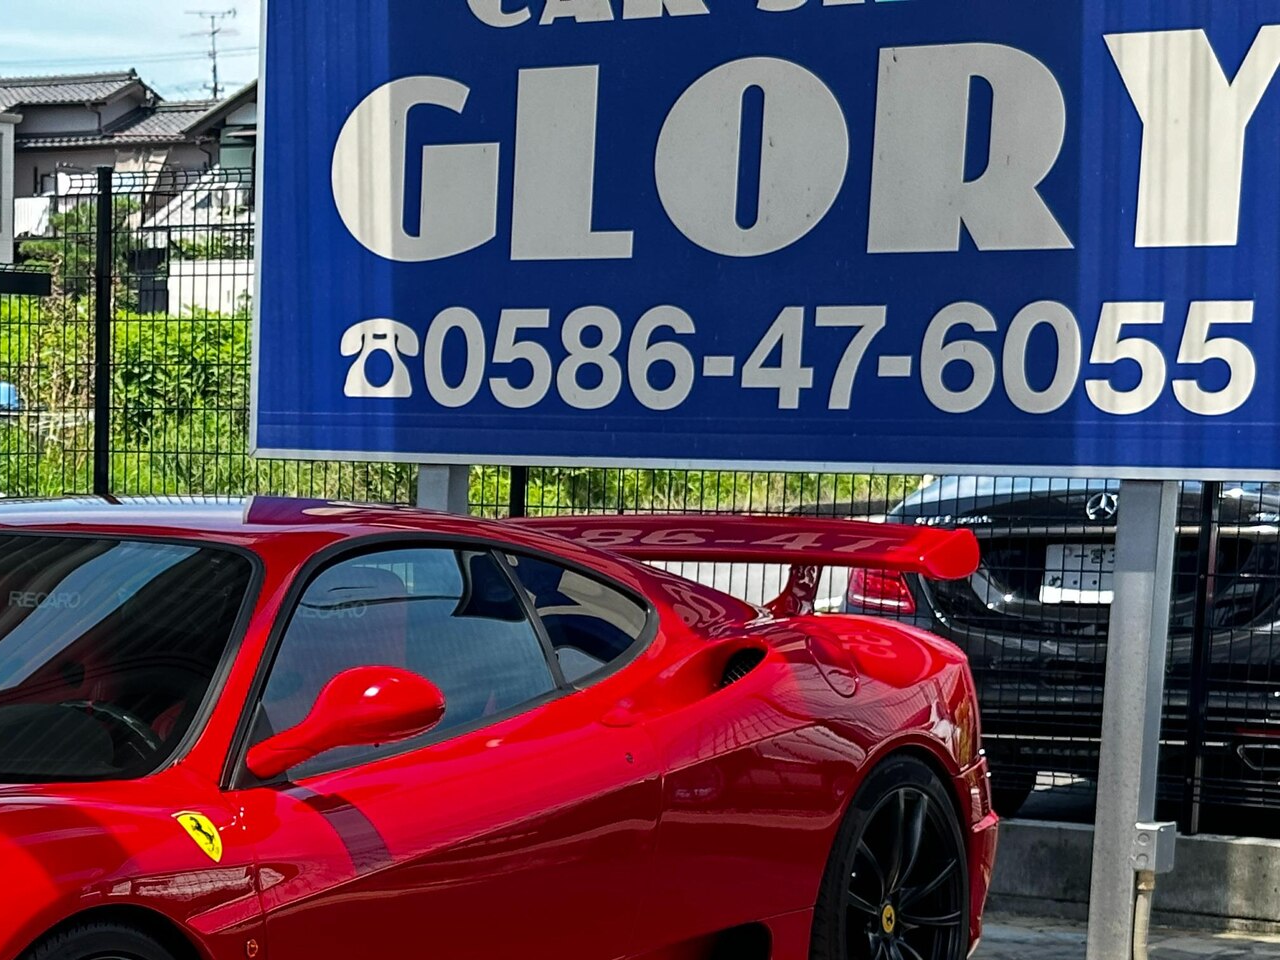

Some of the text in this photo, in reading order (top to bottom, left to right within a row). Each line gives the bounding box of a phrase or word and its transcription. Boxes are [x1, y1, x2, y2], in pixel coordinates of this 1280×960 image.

[331, 24, 1280, 263] GLORY
[423, 299, 1256, 416] 0586-47-6055
[8, 590, 81, 609] RECARO
